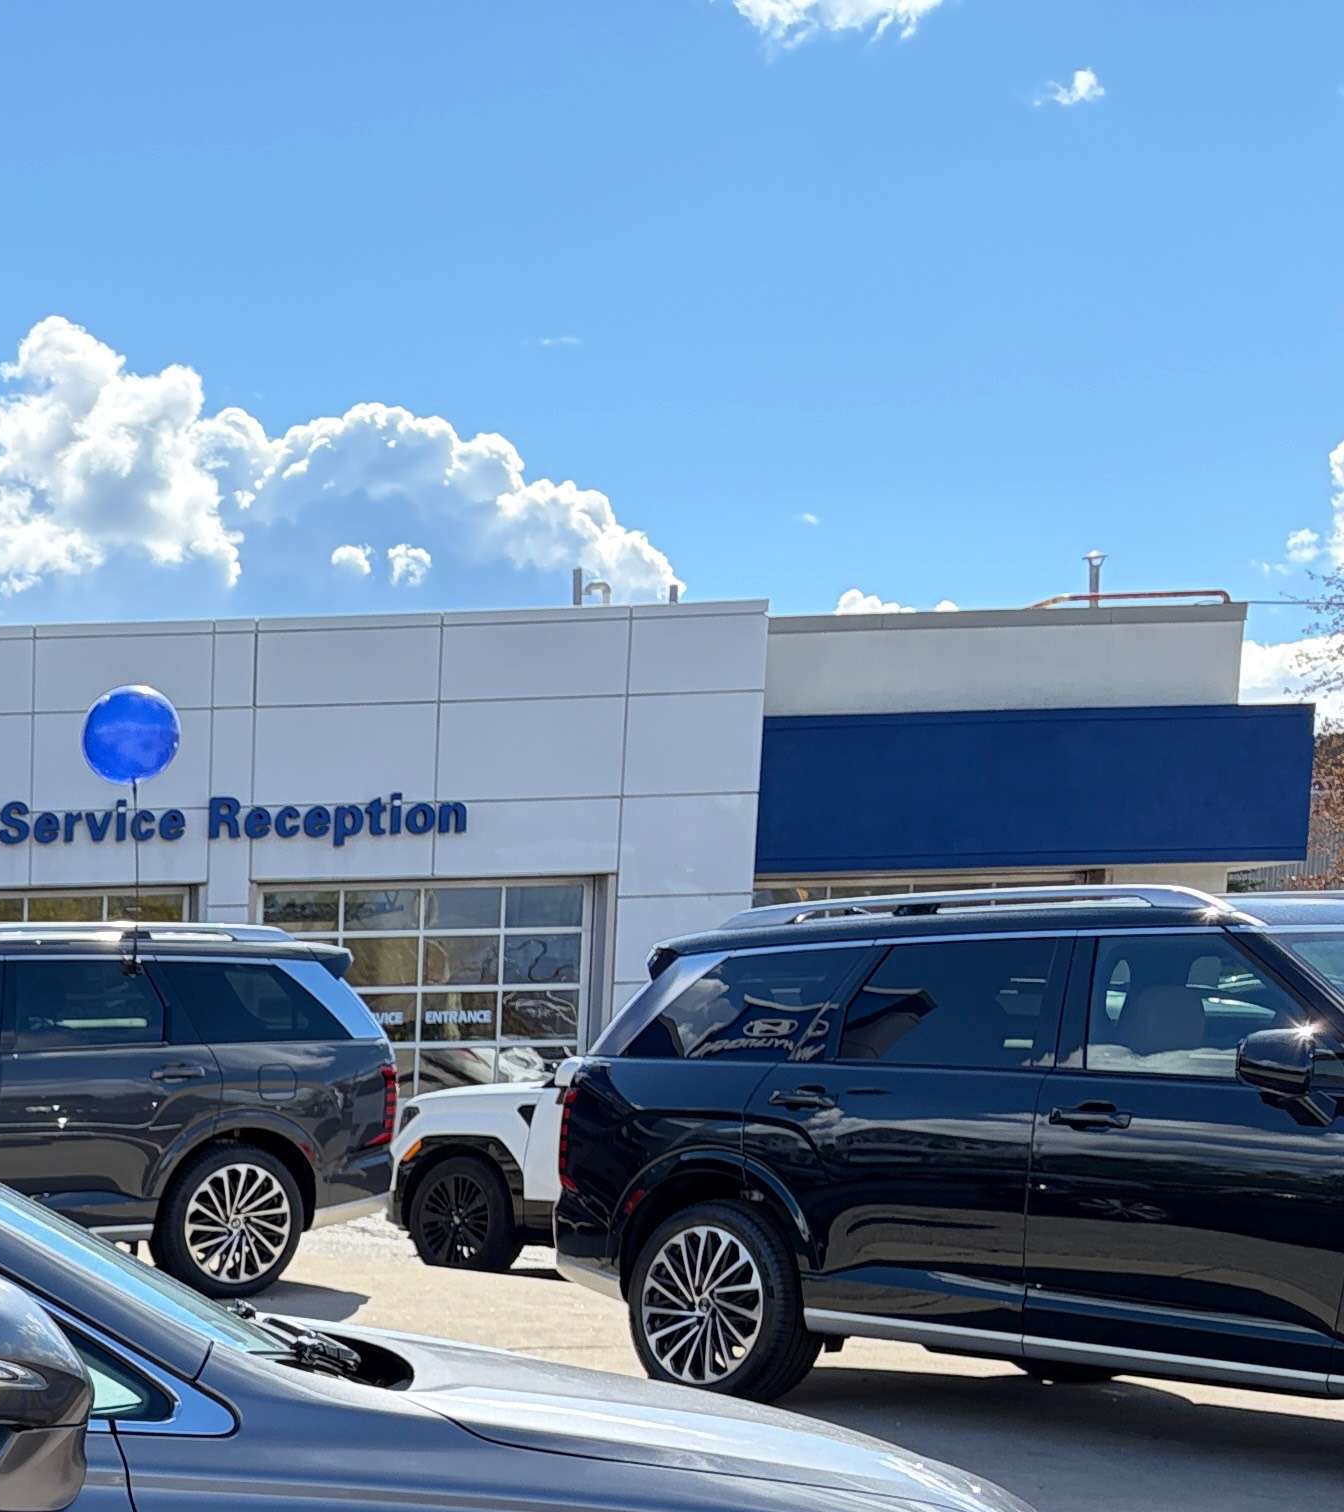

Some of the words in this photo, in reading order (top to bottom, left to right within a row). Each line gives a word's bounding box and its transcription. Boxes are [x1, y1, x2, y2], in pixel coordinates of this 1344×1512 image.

[207, 791, 468, 847] Reception
[374, 1011, 404, 1025] VICE
[424, 1009, 492, 1024] ENTRANCE
